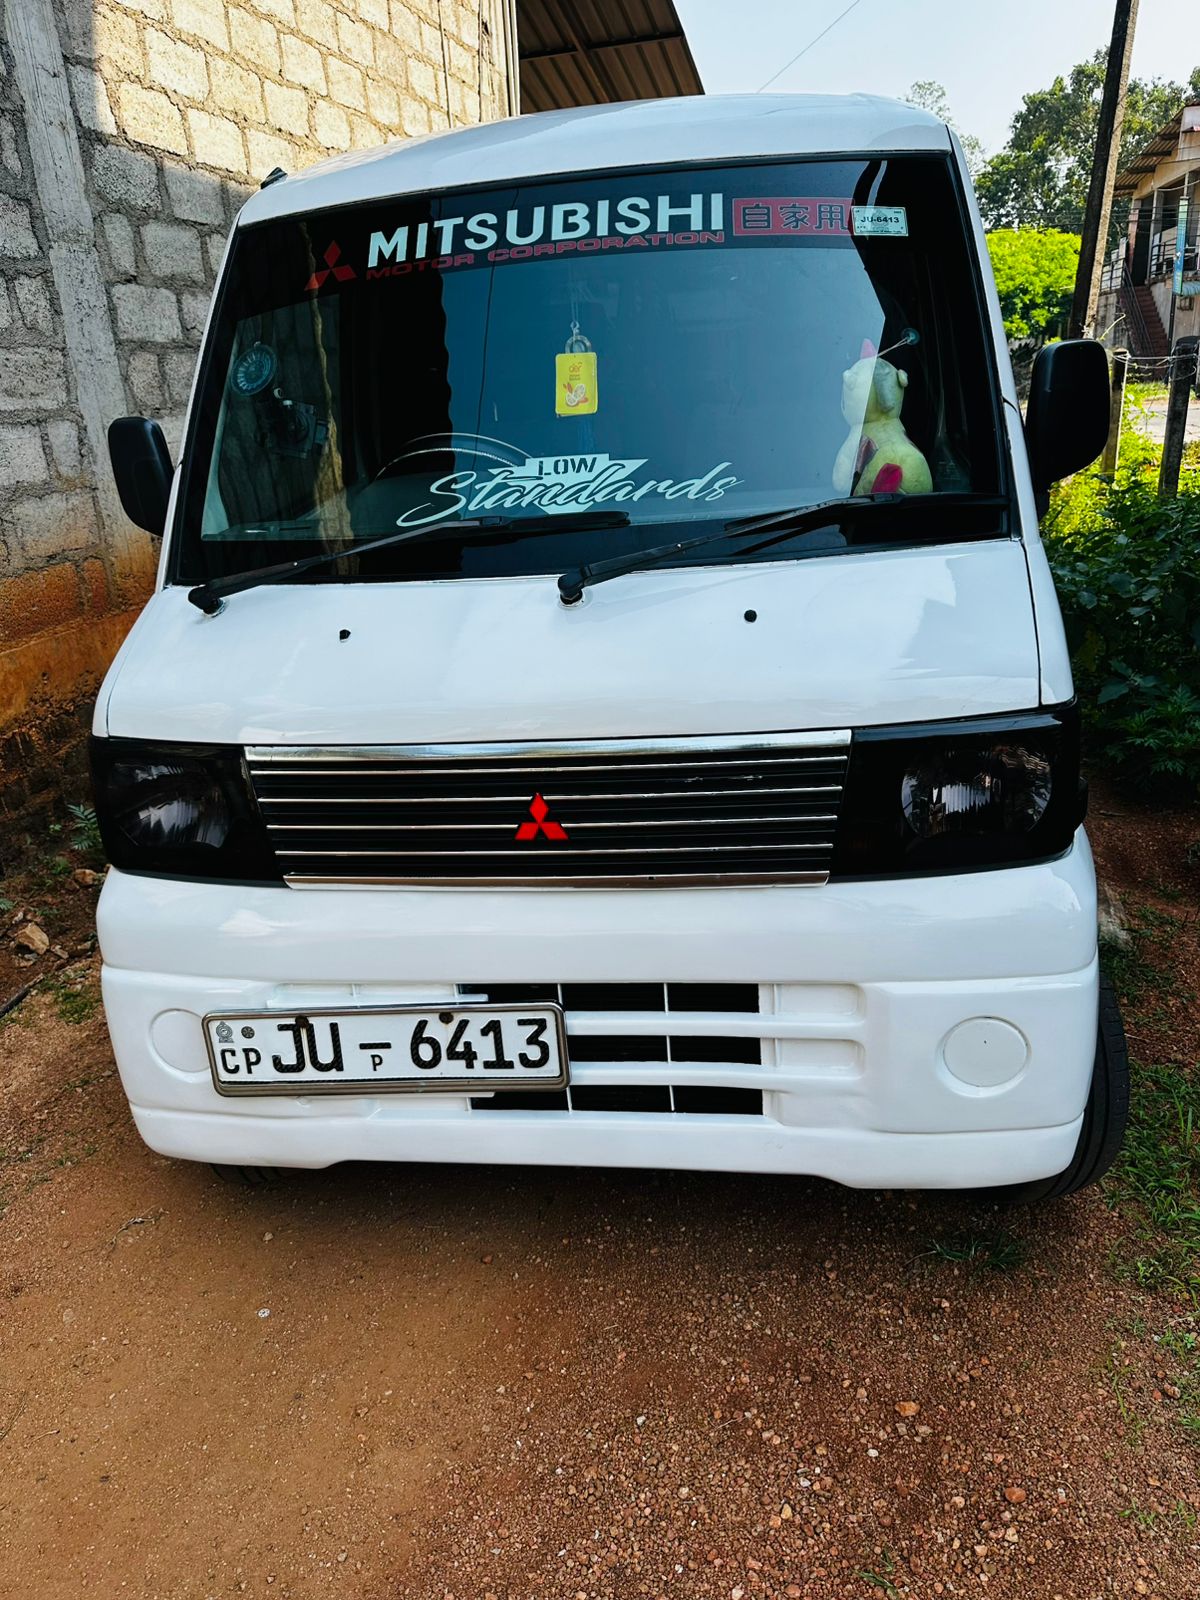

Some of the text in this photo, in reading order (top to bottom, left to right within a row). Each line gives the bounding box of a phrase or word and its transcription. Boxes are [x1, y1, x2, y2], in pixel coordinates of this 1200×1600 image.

[366, 193, 724, 263] MITSUBISHI
[741, 203, 849, 231] 自家用
[366, 230, 725, 280] MOTOR CORPORATION
[538, 457, 598, 477] LOW
[396, 462, 745, 526] Standards
[220, 1048, 262, 1074] CP
[272, 1022, 344, 1073] JU
[410, 1018, 550, 1070] 6413
[371, 1054, 383, 1072] P
